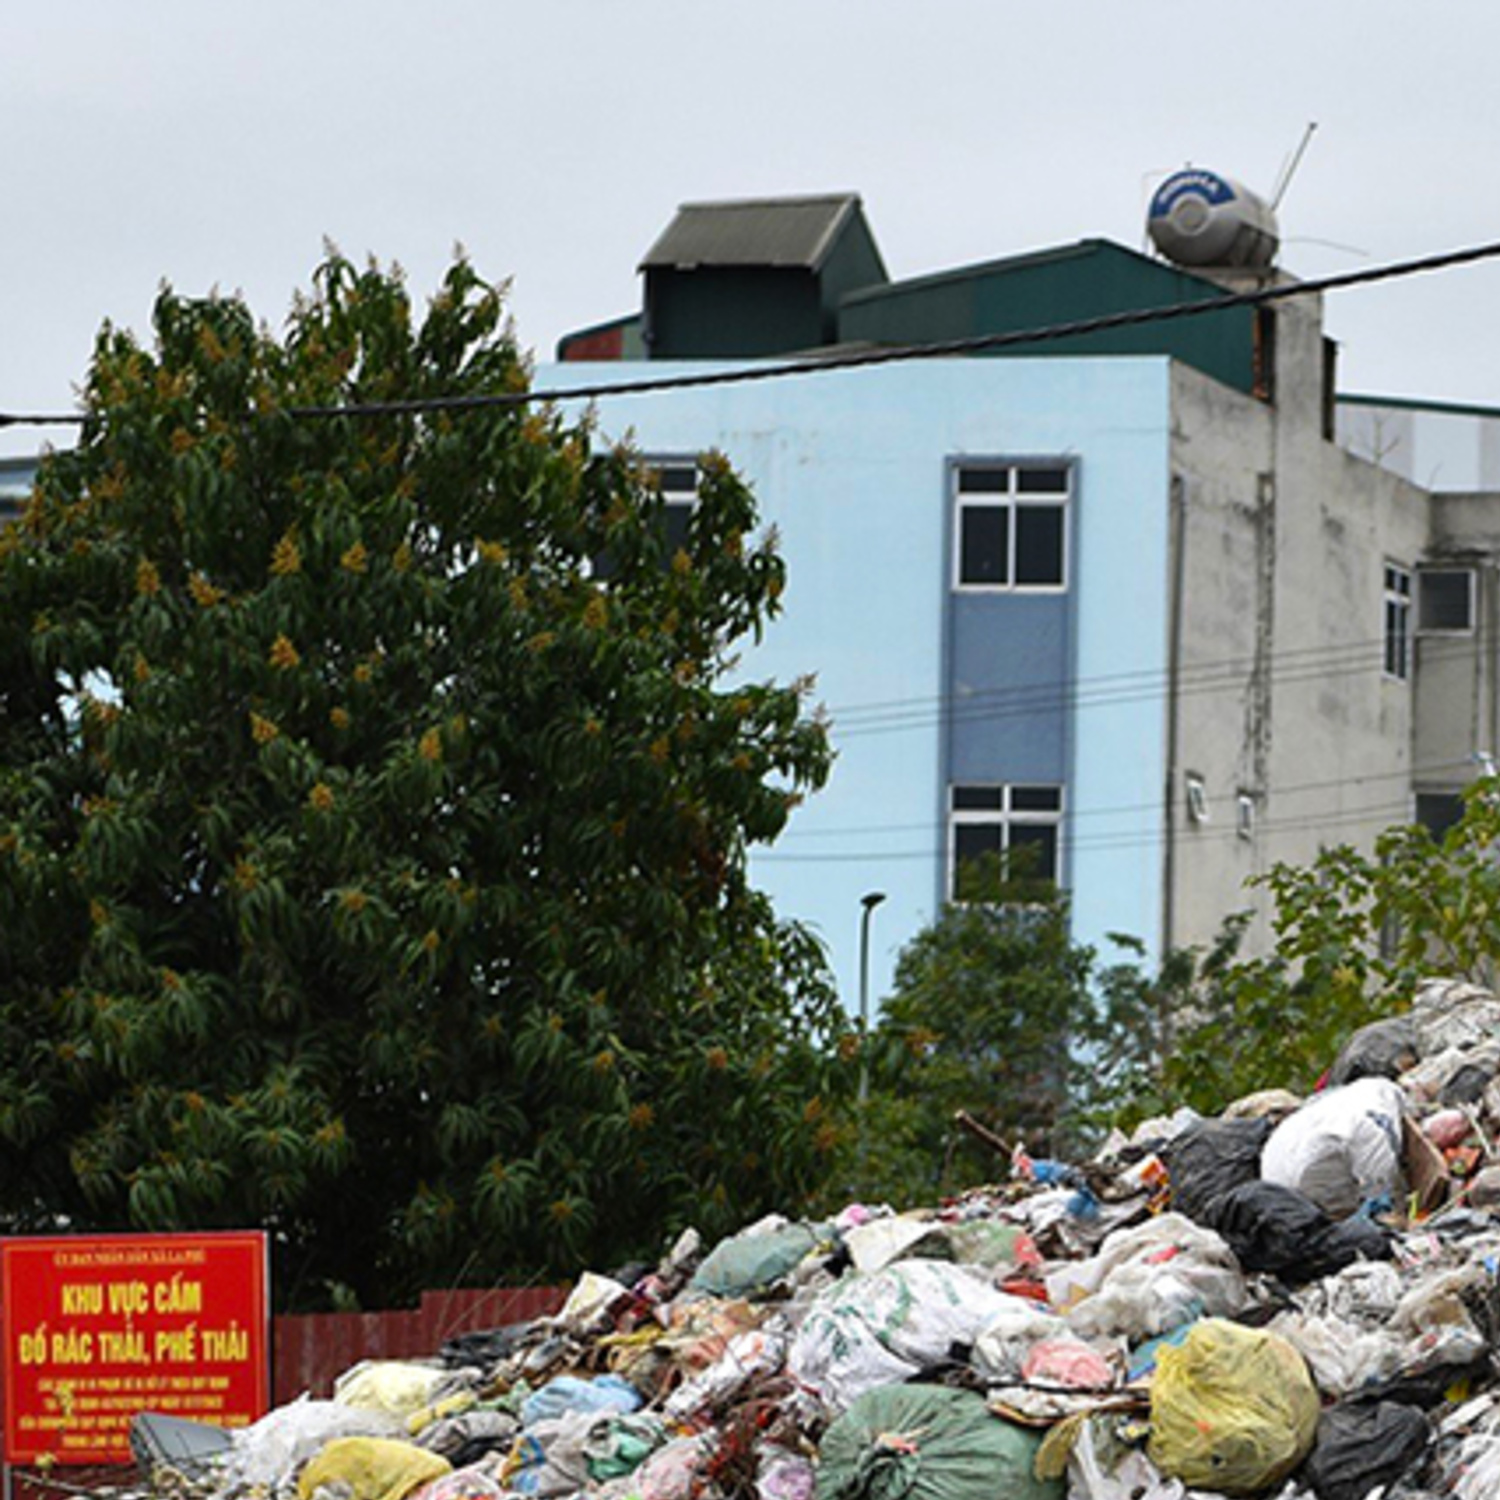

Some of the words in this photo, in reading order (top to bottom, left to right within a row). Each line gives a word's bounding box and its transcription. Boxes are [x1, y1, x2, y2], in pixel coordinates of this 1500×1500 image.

[61, 1283, 103, 1315] KHU
[108, 1279, 150, 1321] VỰC
[153, 1270, 202, 1315] CẤM
[51, 1325, 93, 1364] RÁC
[155, 1320, 198, 1363] PHẾ
[201, 1319, 248, 1362] THẢI
